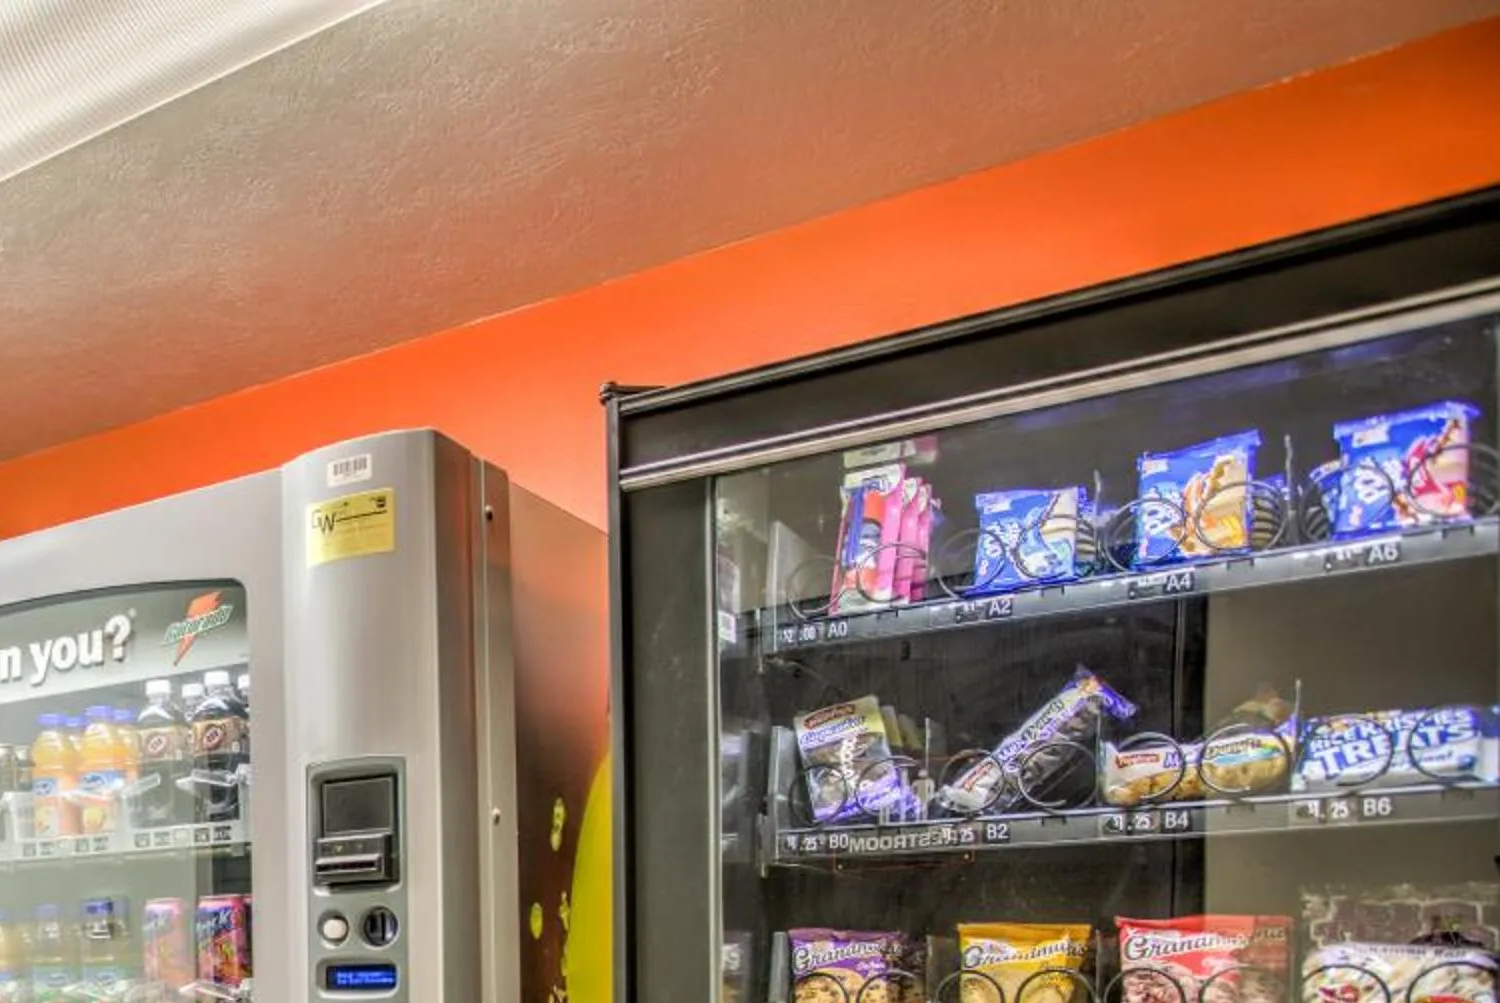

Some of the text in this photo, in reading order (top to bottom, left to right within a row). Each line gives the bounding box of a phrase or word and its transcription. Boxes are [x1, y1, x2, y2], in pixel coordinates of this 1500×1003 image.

[1368, 545, 1398, 563] A6
[1167, 572, 1191, 591] A4
[989, 600, 1012, 615] A2
[828, 621, 847, 638] A0
[34, 613, 134, 685] you?
[1363, 799, 1392, 816] B6
[1165, 812, 1189, 828] B4
[829, 833, 849, 849] B0
[986, 825, 1009, 840] B2
